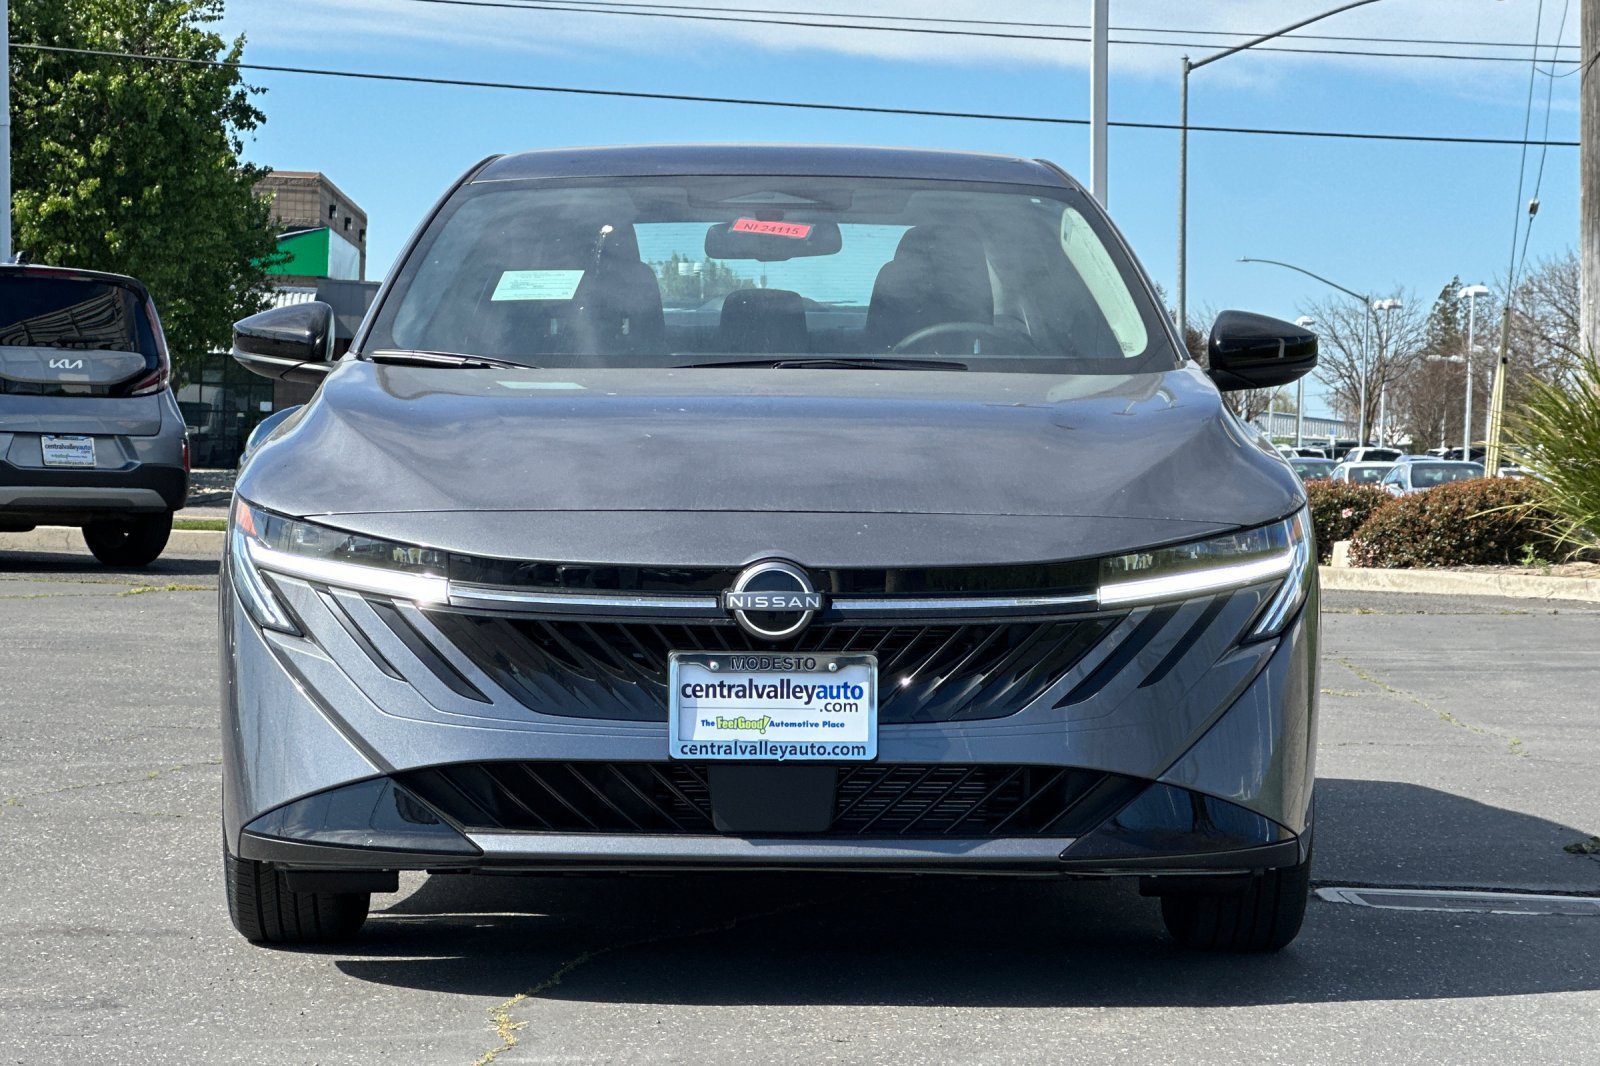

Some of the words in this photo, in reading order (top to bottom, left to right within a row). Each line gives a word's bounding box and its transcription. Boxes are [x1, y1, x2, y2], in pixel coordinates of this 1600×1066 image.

[760, 225, 800, 235] 24115
[49, 358, 83, 369] KIA
[729, 596, 820, 608] NISSAN
[731, 656, 817, 671] MODESTO
[681, 678, 864, 706] centralvalleyauto
[819, 701, 859, 713] .com
[701, 719, 716, 727] The
[769, 720, 820, 728] Automotive
[822, 720, 845, 728] Place
[680, 740, 867, 760] centralvalleyauto.com
